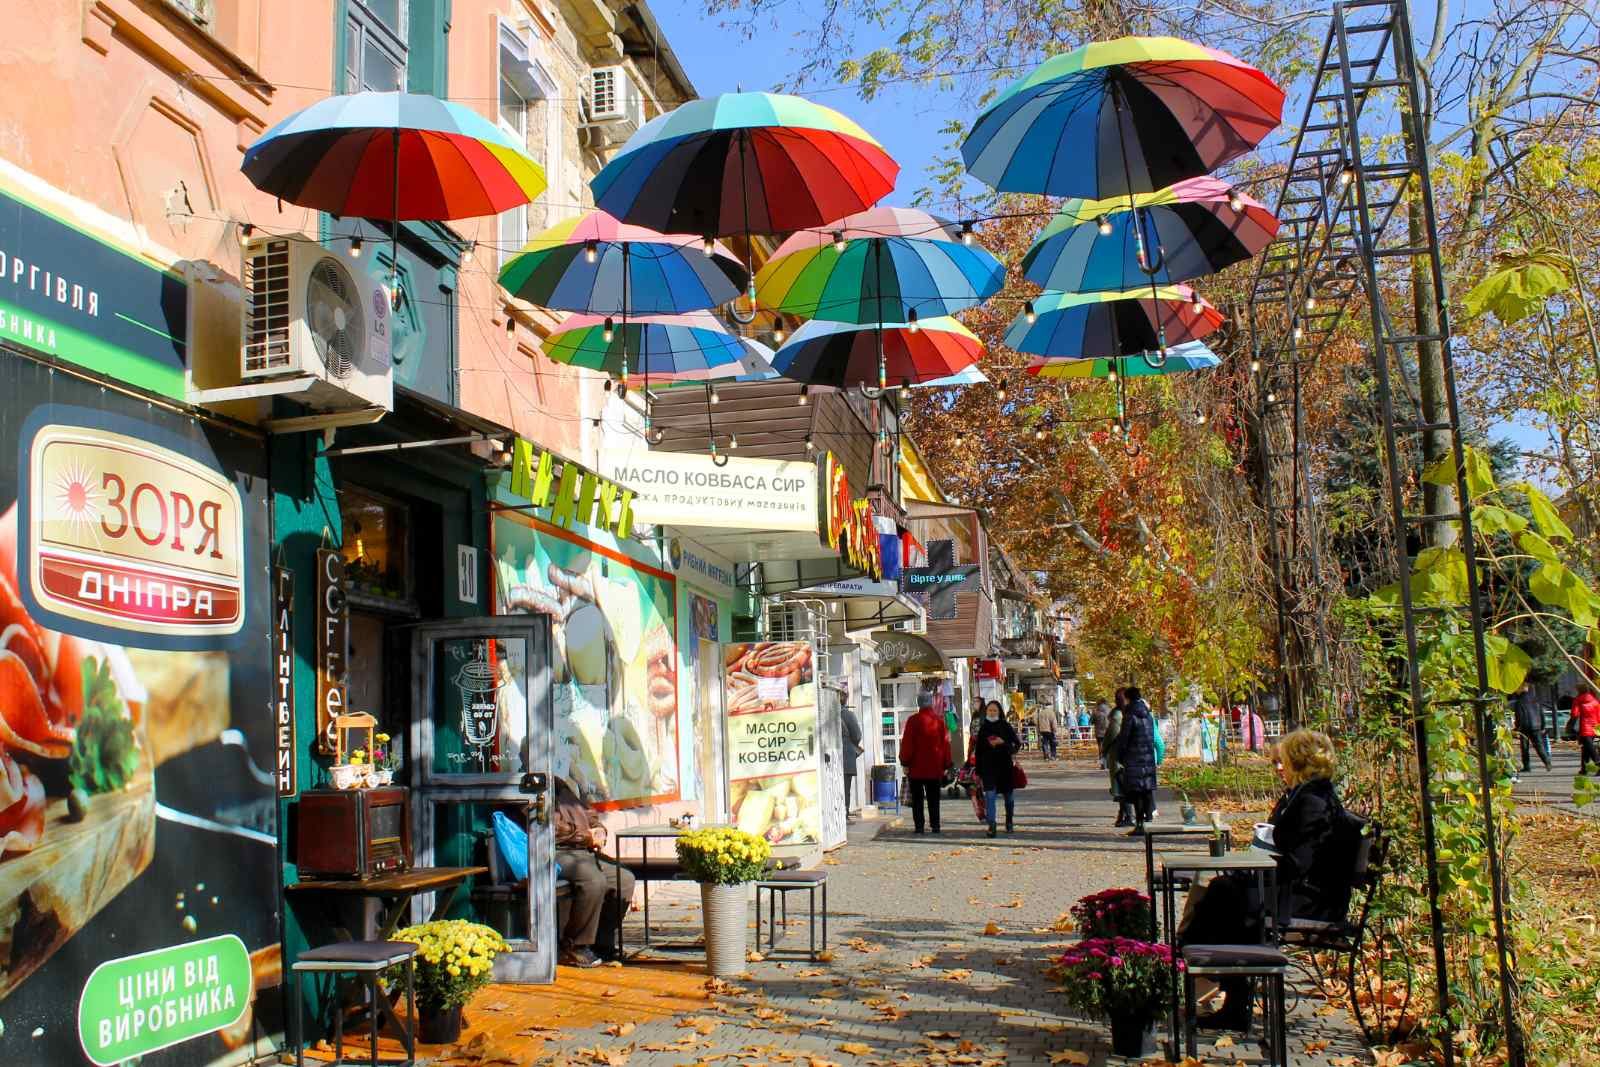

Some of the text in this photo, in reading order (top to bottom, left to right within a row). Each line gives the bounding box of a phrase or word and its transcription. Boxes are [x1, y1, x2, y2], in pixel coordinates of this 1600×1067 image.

[374, 319, 385, 336] LG
[614, 466, 807, 493] МАСЛО КОВБАСА СИР
[101, 472, 223, 560] ЗОРЯ
[78, 570, 213, 617] ДНІПРА
[746, 721, 797, 735] МАСЛО
[757, 736, 787, 748] СИР
[738, 750, 806, 764] КОВБАСА
[118, 955, 220, 1007] ЦІНИ ВІД
[98, 984, 236, 1049] ВИРОБНИКА
